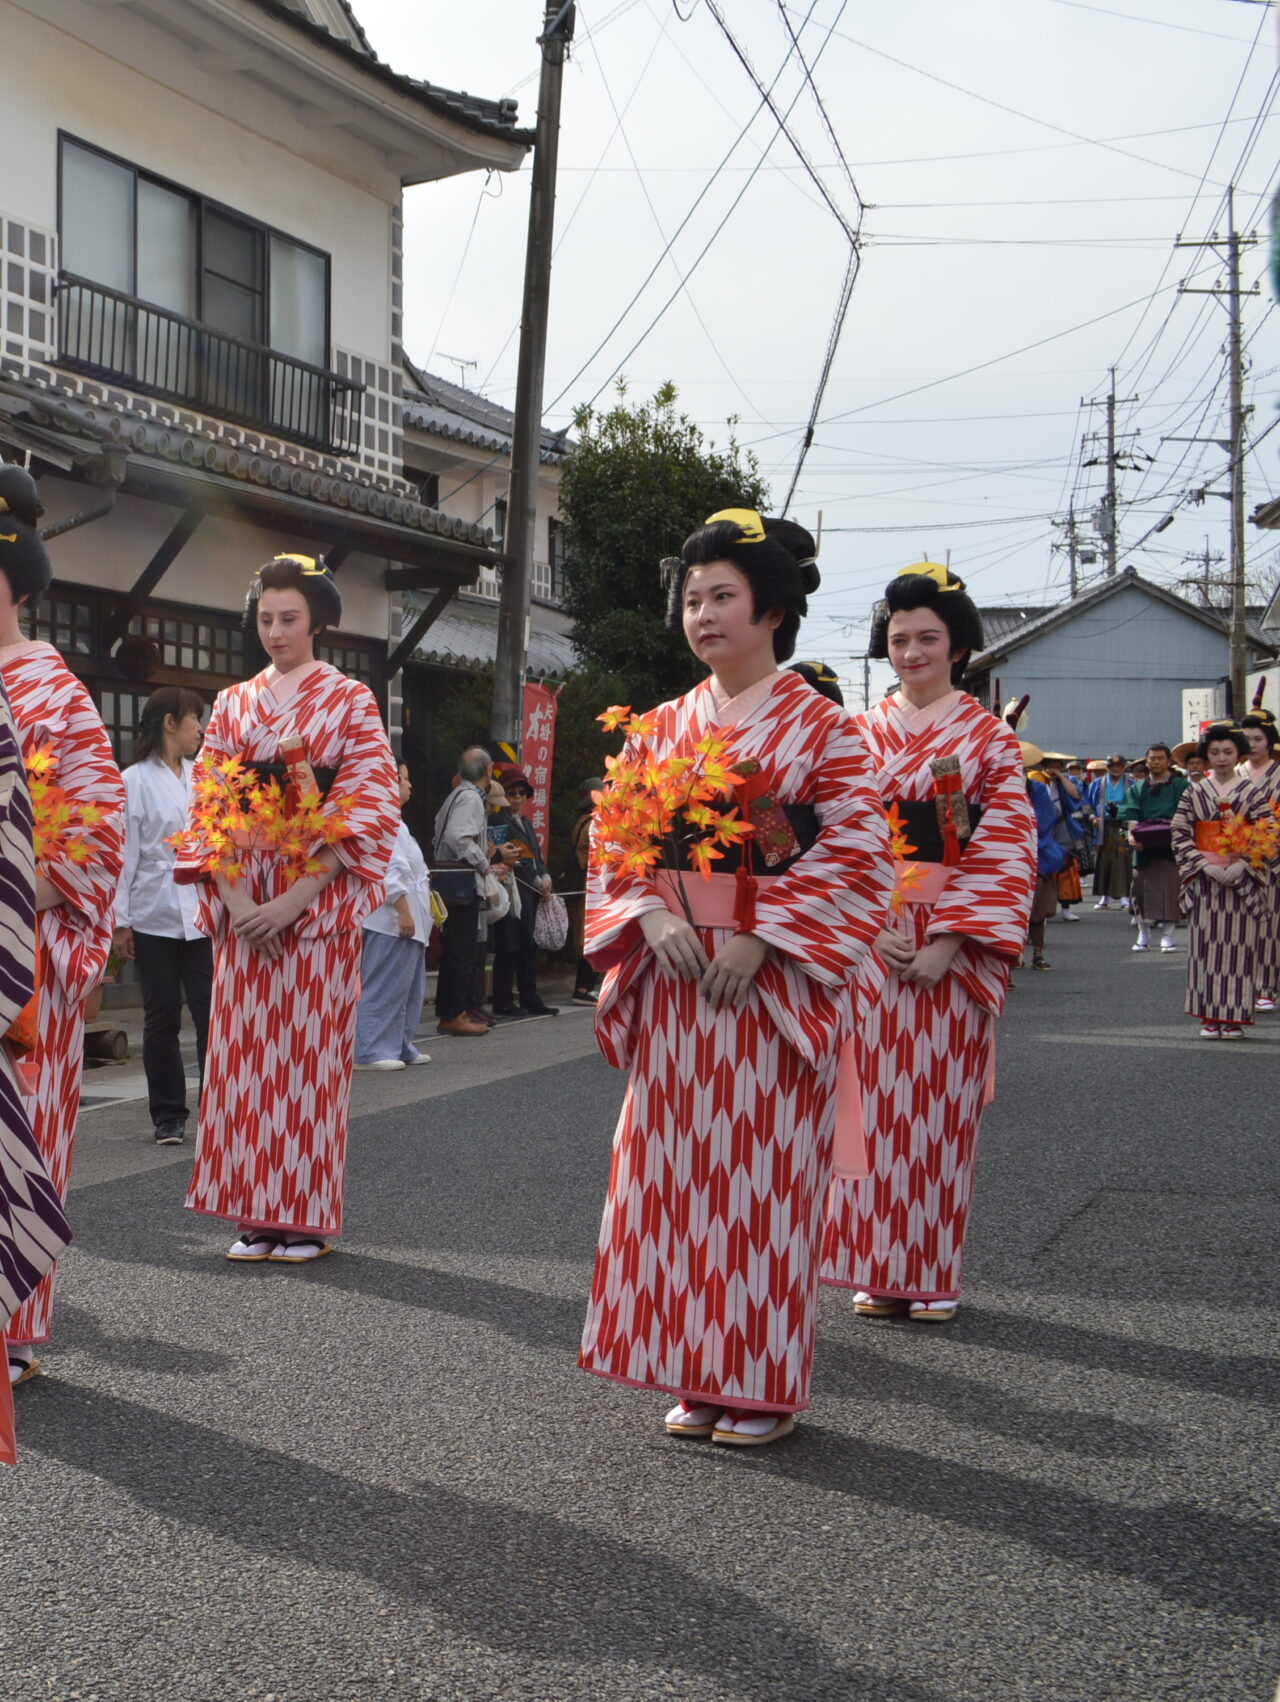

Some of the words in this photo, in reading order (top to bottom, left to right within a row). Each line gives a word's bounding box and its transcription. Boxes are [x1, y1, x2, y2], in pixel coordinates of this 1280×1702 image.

[532, 702, 553, 860] 矢掛の宿場まつ
